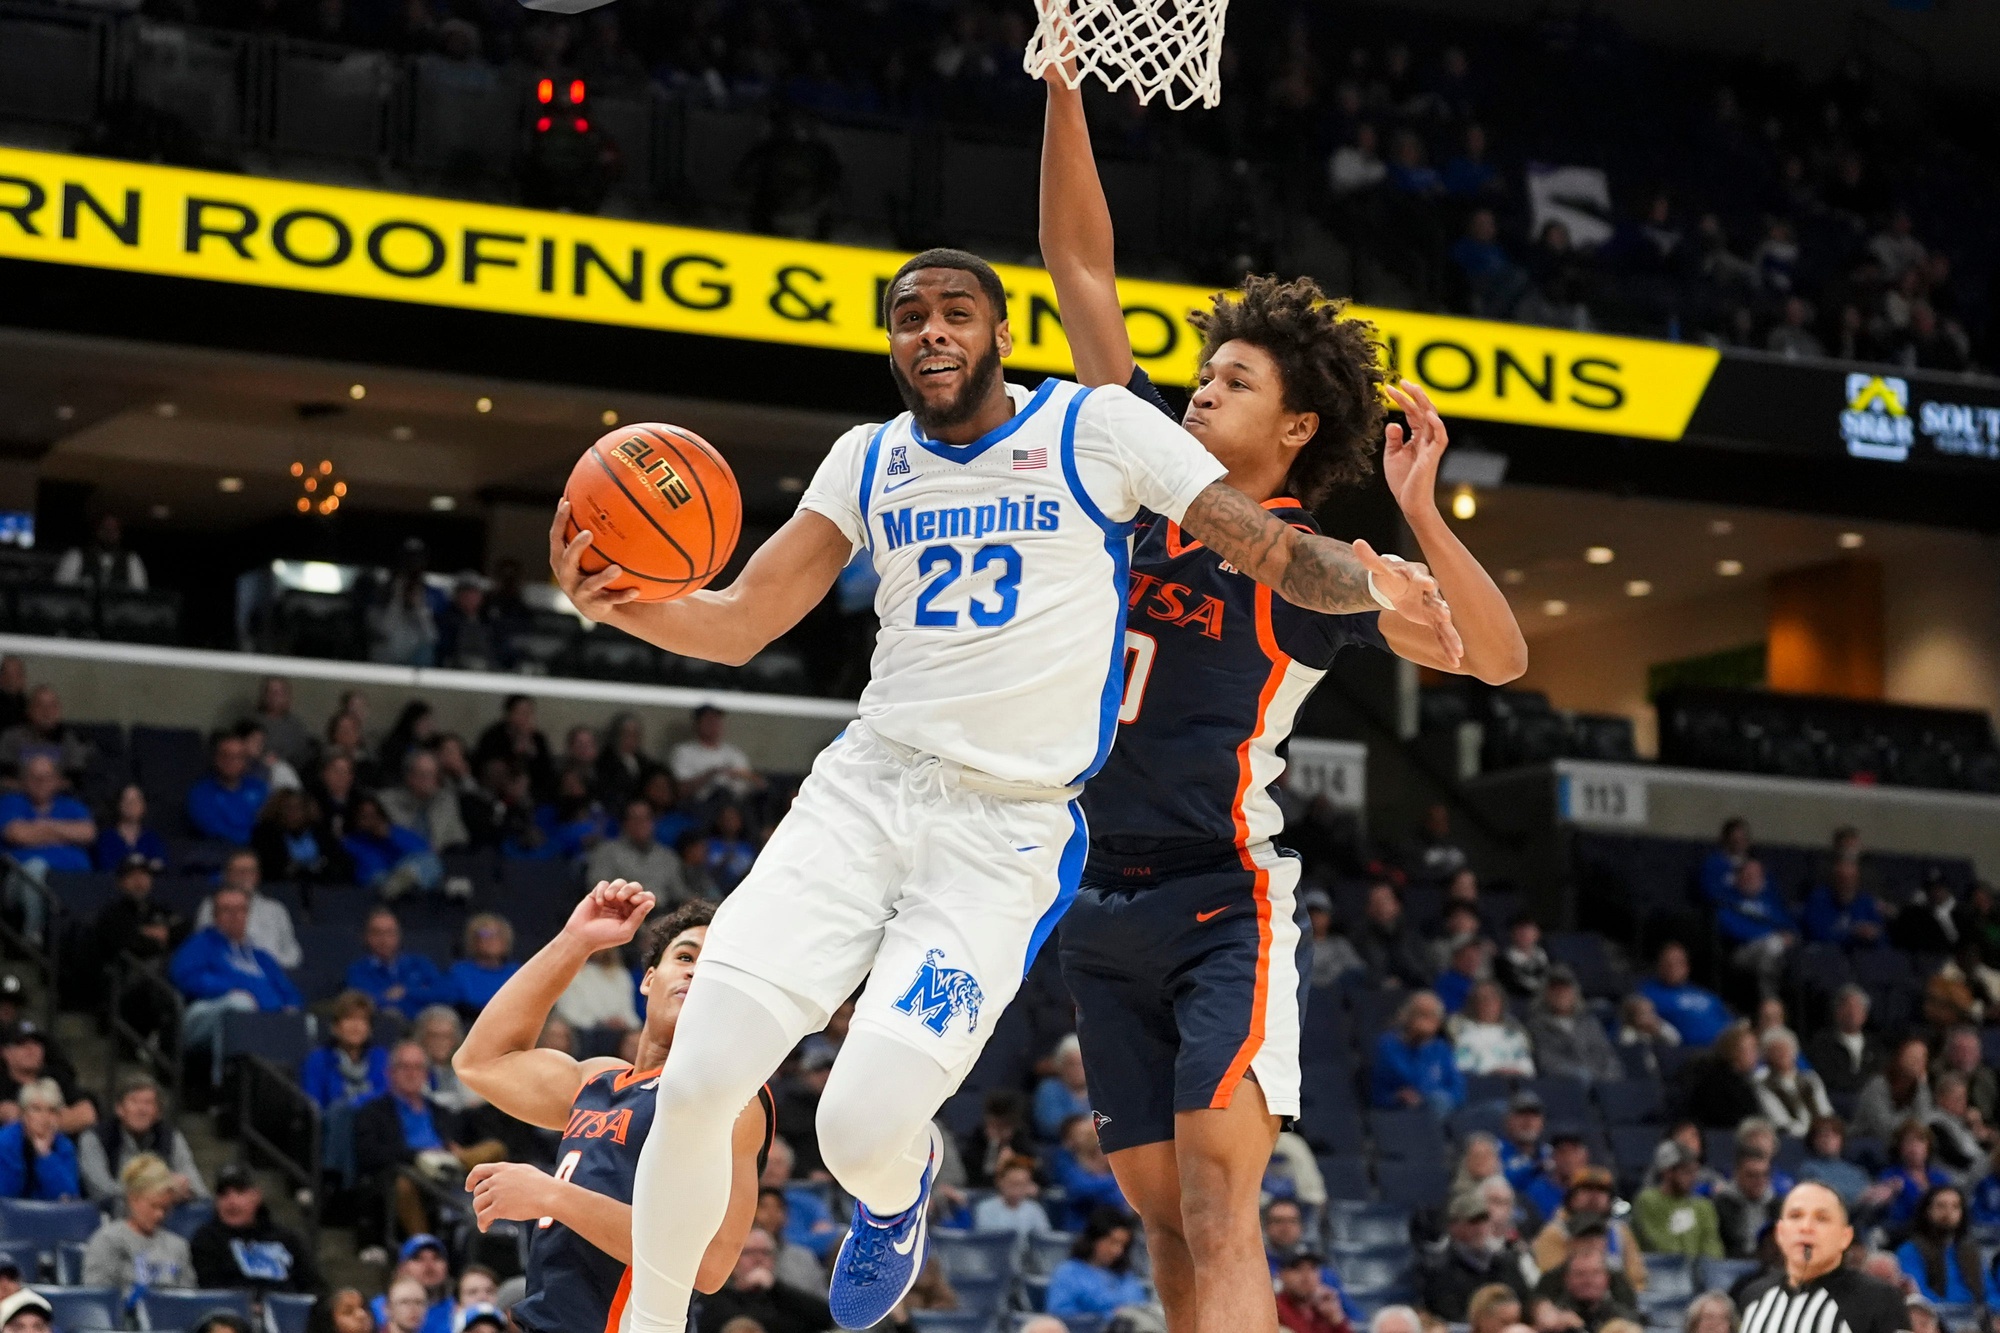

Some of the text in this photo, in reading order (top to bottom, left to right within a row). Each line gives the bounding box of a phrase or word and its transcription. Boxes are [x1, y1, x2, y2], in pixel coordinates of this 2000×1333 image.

[184, 194, 733, 311] ROOFING
[768, 265, 837, 325] &
[610, 449, 672, 513] CHAMPION
[616, 435, 693, 511] ELITE
[879, 493, 1061, 551] Memphis
[914, 543, 1023, 629] 23
[1128, 568, 1225, 642] TSA
[1582, 783, 1628, 816] 113
[1122, 866, 1152, 877] UTSA
[562, 1107, 634, 1147] UTSA
